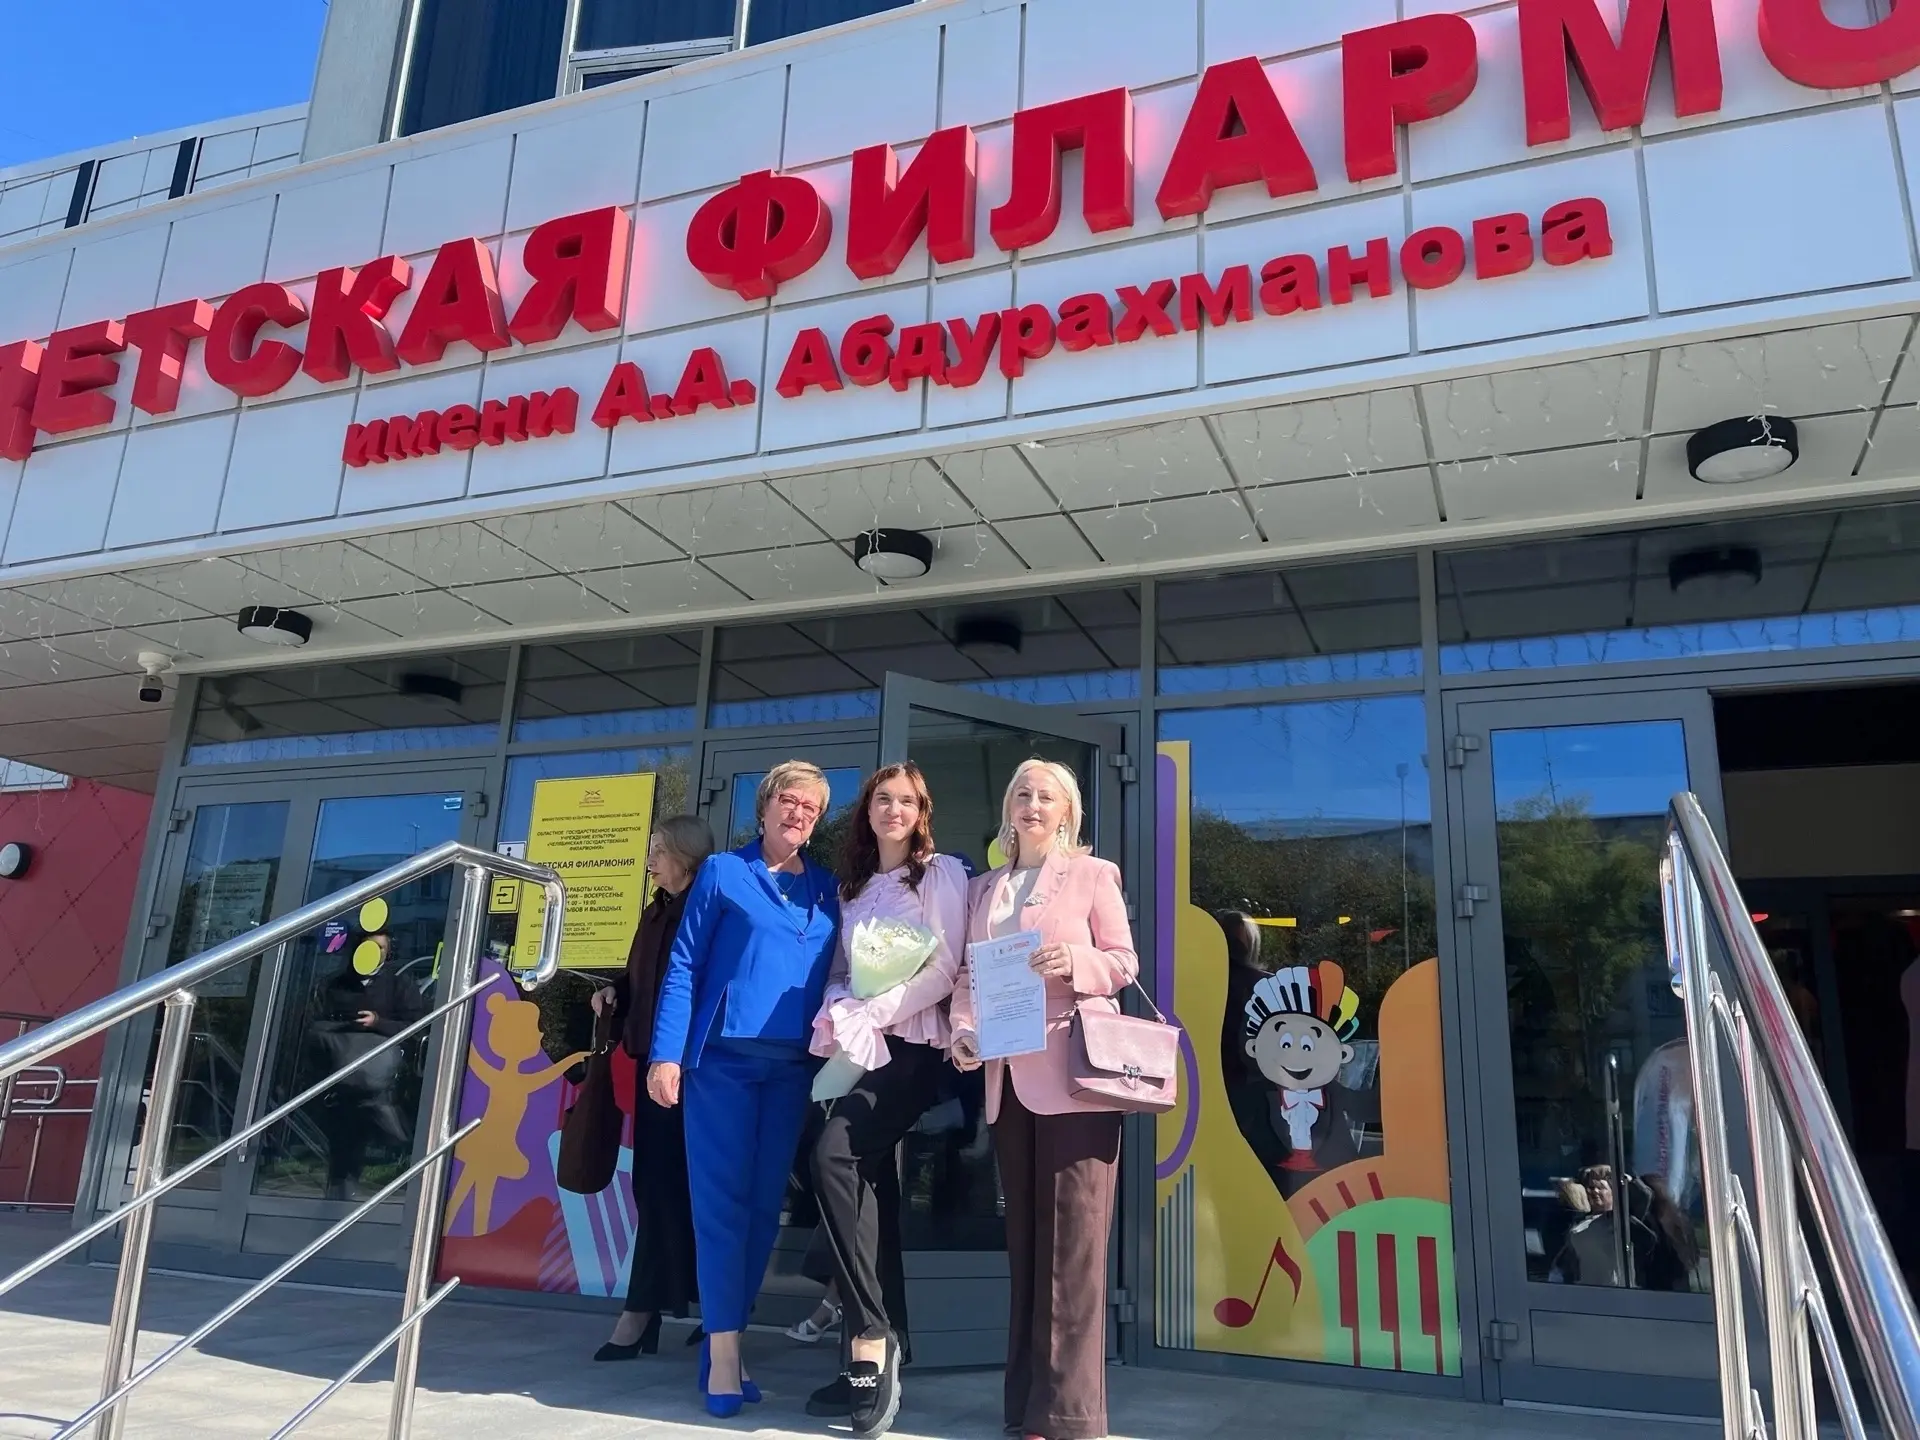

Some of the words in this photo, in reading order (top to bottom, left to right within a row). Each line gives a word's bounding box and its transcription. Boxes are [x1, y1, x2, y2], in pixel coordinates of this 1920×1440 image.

[342, 387, 579, 467] имени
[591, 347, 756, 428] А.А.
[776, 198, 1613, 398] Абдурахманова
[575, 858, 635, 868] ФИЛАРМОНИЯ
[583, 891, 624, 899] ВОСКРЕСЕНЬЕ
